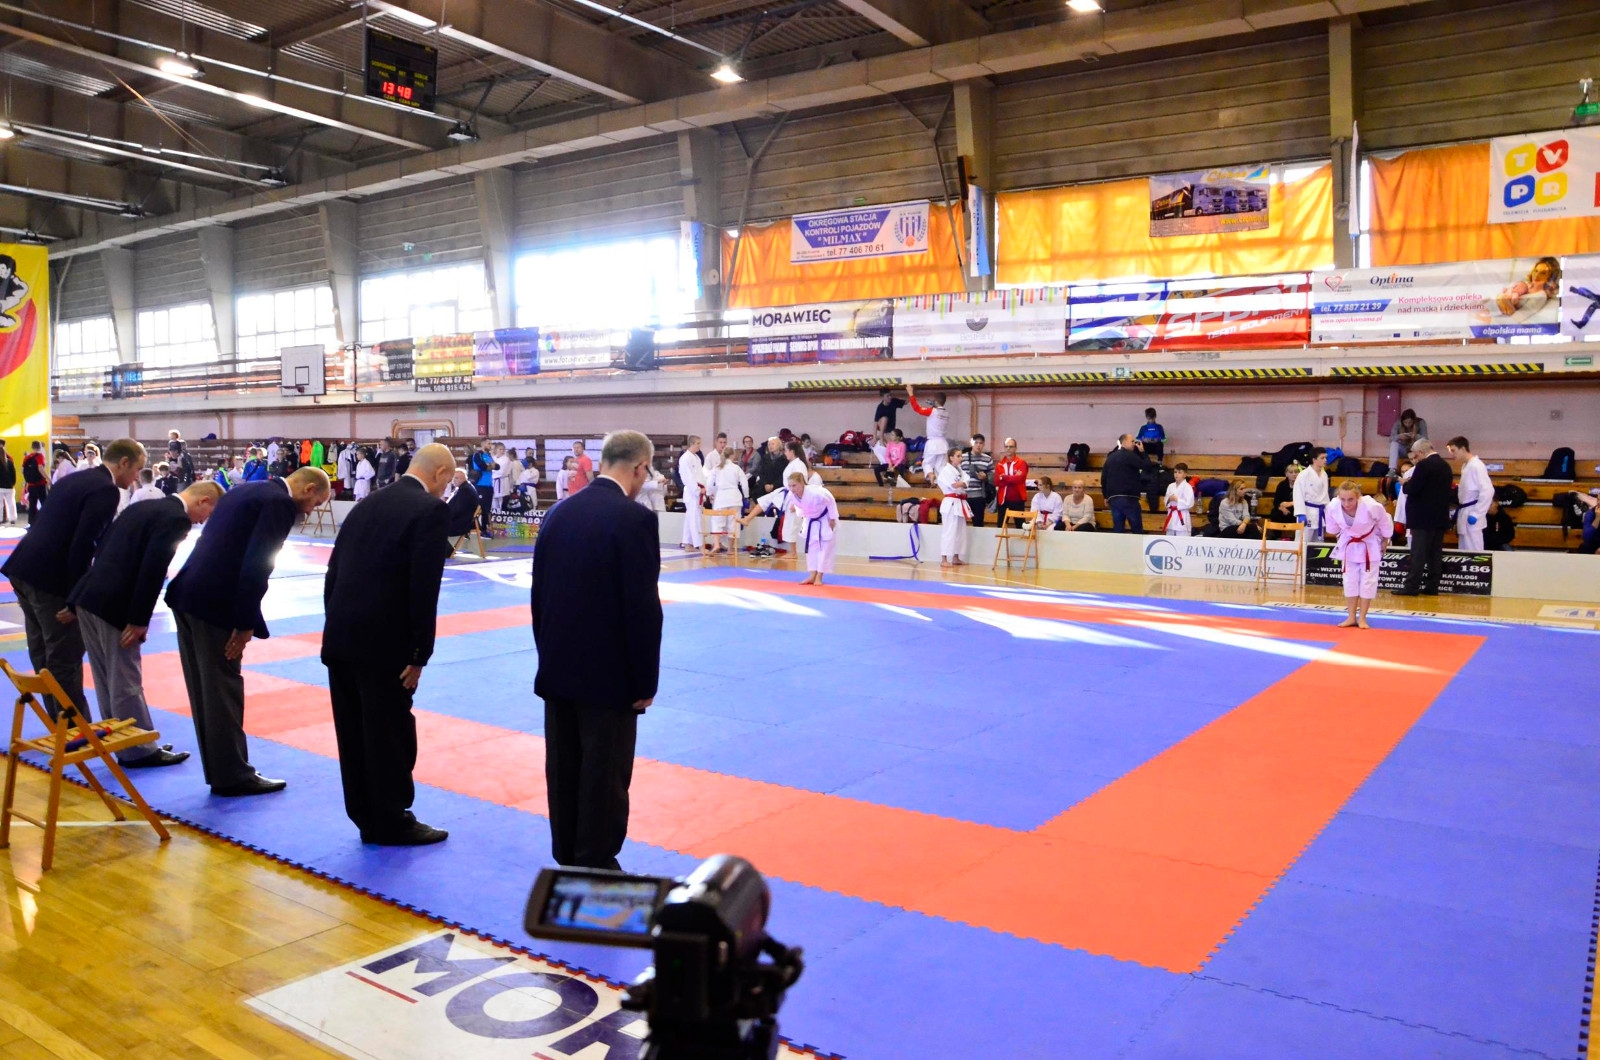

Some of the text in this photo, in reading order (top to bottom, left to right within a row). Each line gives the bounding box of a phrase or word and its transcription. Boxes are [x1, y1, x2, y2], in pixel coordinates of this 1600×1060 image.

[382, 81, 412, 100] 13 48
[808, 213, 877, 228] OKRĘGOWA STACJA
[804, 222, 881, 237] KONTROLI POJAZDÓW
[827, 249, 838, 257] tel.
[839, 247, 848, 255] 77
[849, 246, 863, 255] 406
[865, 245, 873, 253] 70
[875, 244, 885, 252] 61
[1370, 273, 1414, 287] Optima
[1398, 293, 1483, 305] Kompleksowa opieka
[1320, 305, 1332, 313] tel.
[1333, 304, 1345, 312] 77
[1360, 302, 1370, 311] 21
[1397, 306, 1412, 314] nad
[1444, 302, 1485, 311] dzieckiem
[752, 309, 831, 328] MORAWIEC
[1206, 309, 1303, 340] TEAM EQUIPMENT
[1516, 326, 1543, 335] mama
[1185, 545, 1215, 558] BANK
[1164, 556, 1183, 571] BS
[1204, 563, 1213, 574] W
[1460, 565, 1491, 573] 186
[1456, 580, 1490, 588] PLAKATY
